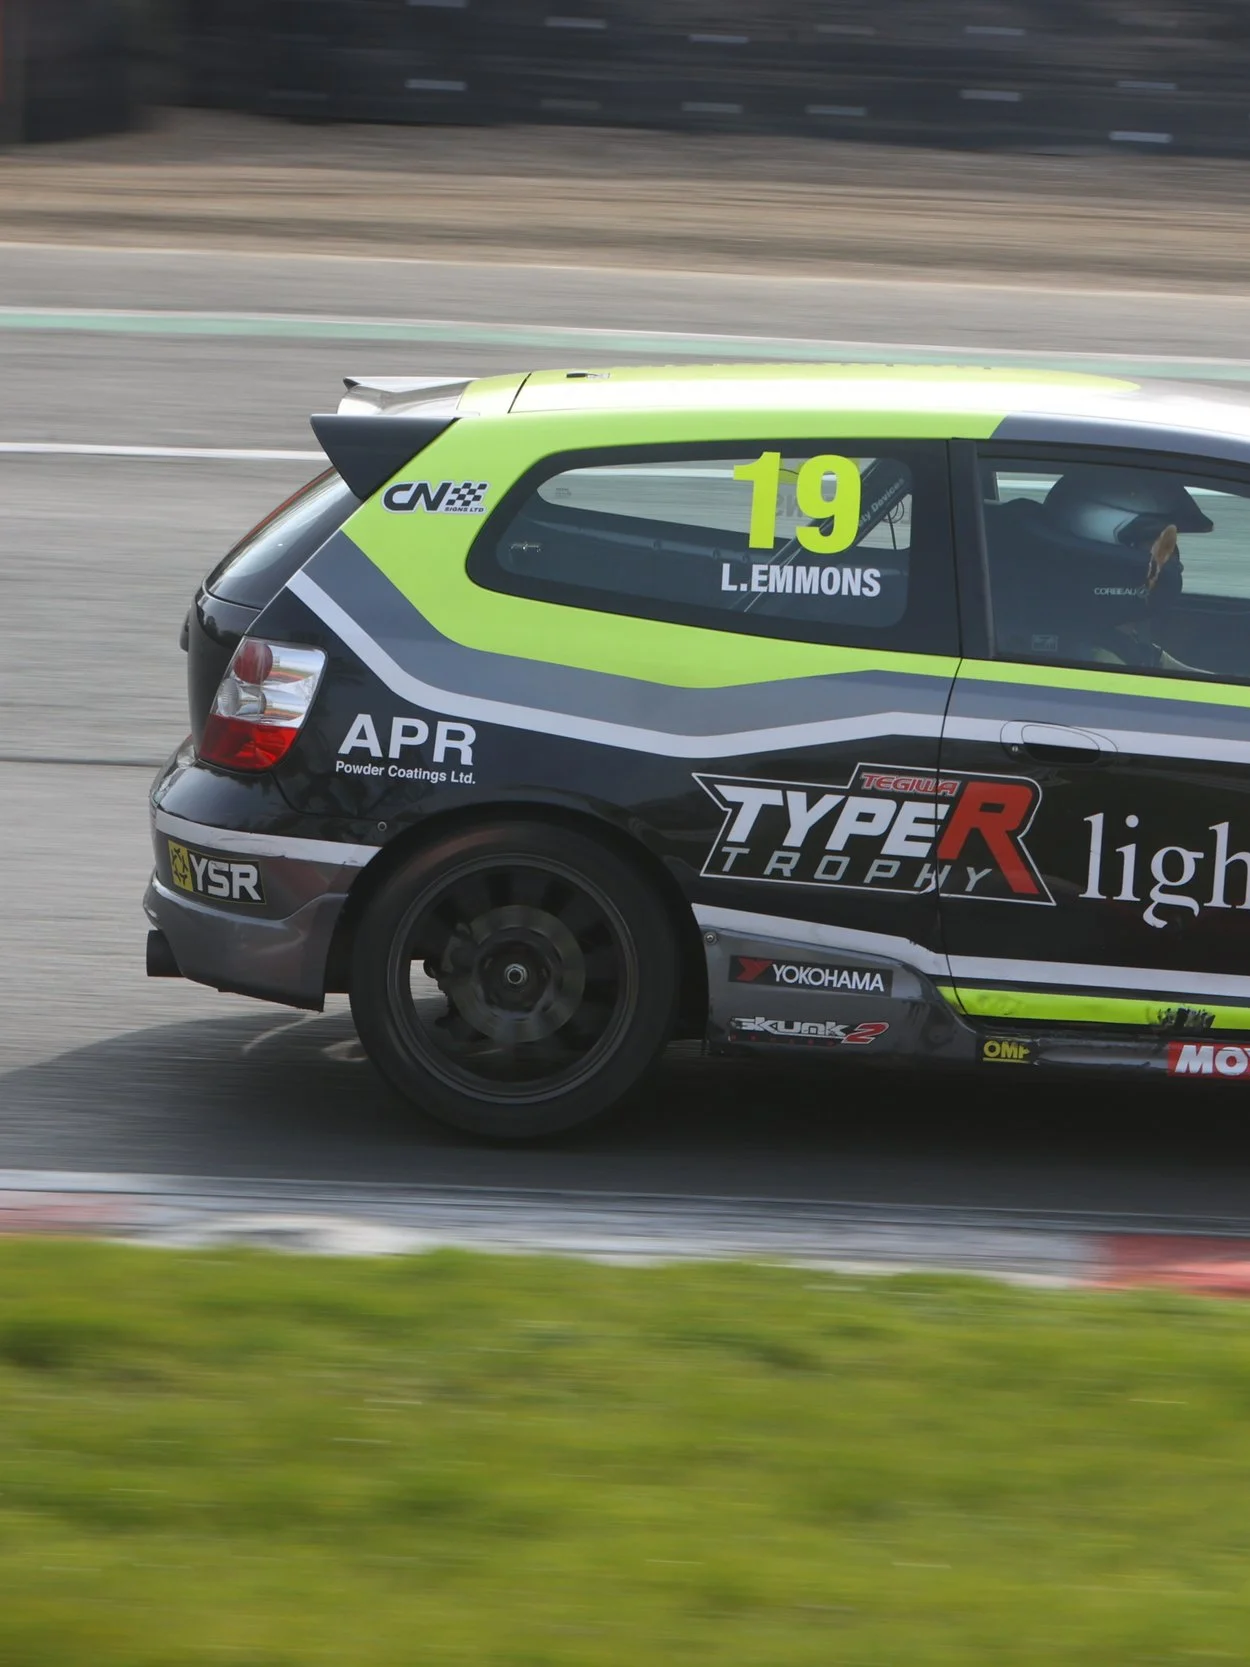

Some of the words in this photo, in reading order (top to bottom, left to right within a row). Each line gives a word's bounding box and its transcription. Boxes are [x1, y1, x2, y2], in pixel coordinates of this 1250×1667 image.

[383, 482, 453, 511] CN
[733, 452, 861, 554] 19
[721, 563, 881, 597] L.EMMONS
[337, 713, 477, 766] APR
[335, 760, 384, 776] Powder
[388, 765, 447, 783] Coatings
[451, 770, 476, 785] Ltd.
[862, 773, 960, 796] TEGIWA
[713, 784, 950, 858] TYPE
[190, 852, 262, 901] YSR
[721, 846, 992, 892] TROPHY
[772, 963, 885, 992] YOKOHAMA
